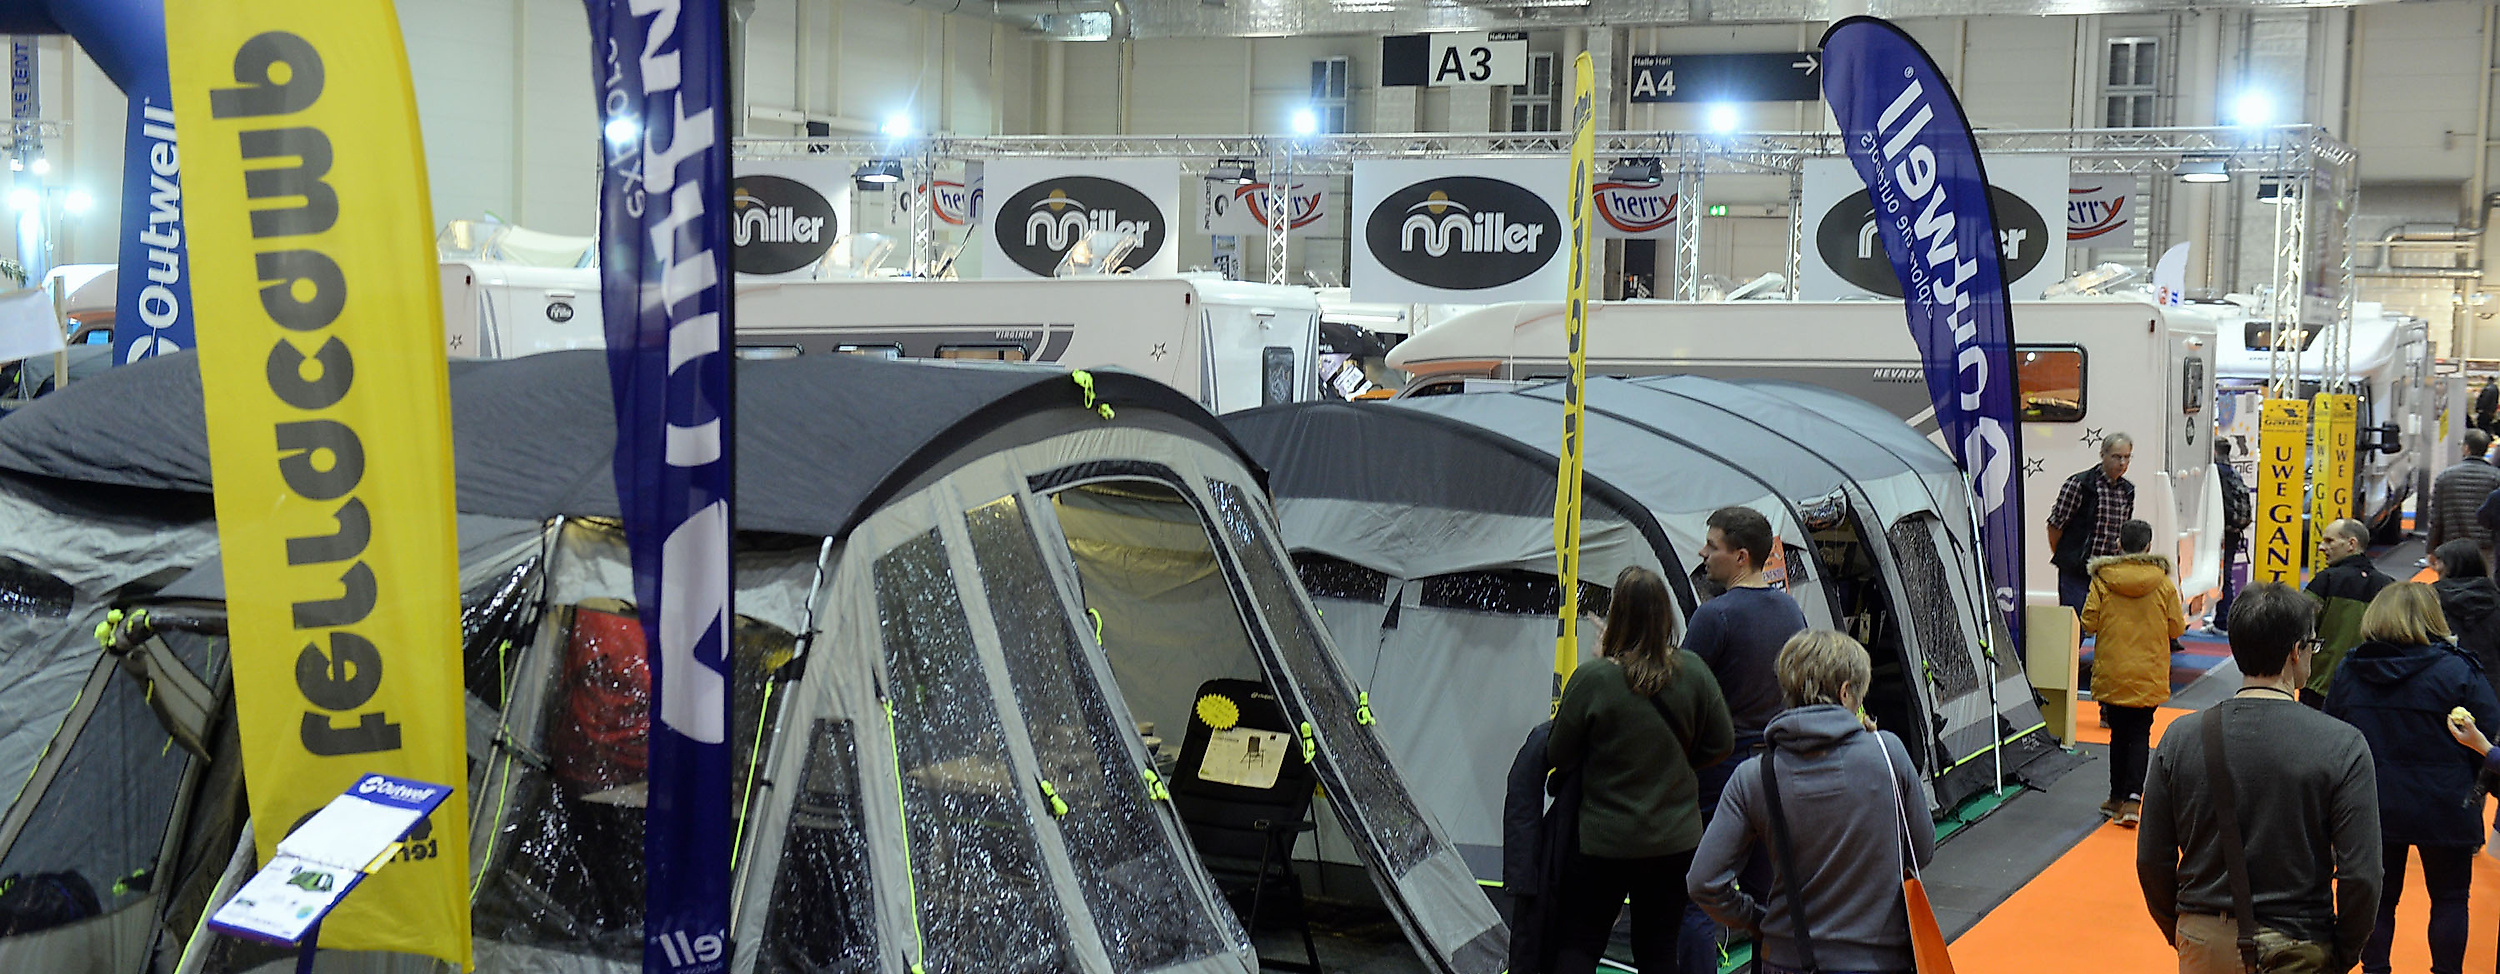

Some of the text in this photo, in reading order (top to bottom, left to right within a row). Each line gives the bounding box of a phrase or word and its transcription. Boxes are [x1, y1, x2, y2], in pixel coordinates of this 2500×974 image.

[1436, 46, 1492, 82] A3
[1633, 56, 1672, 67] Halle Hall
[1633, 69, 1677, 97] A4
[138, 105, 180, 329] Outwell
[1401, 212, 1544, 258] Miller
[1873, 368, 1924, 378] NEVADA
[2271, 446, 2294, 497] UWE
